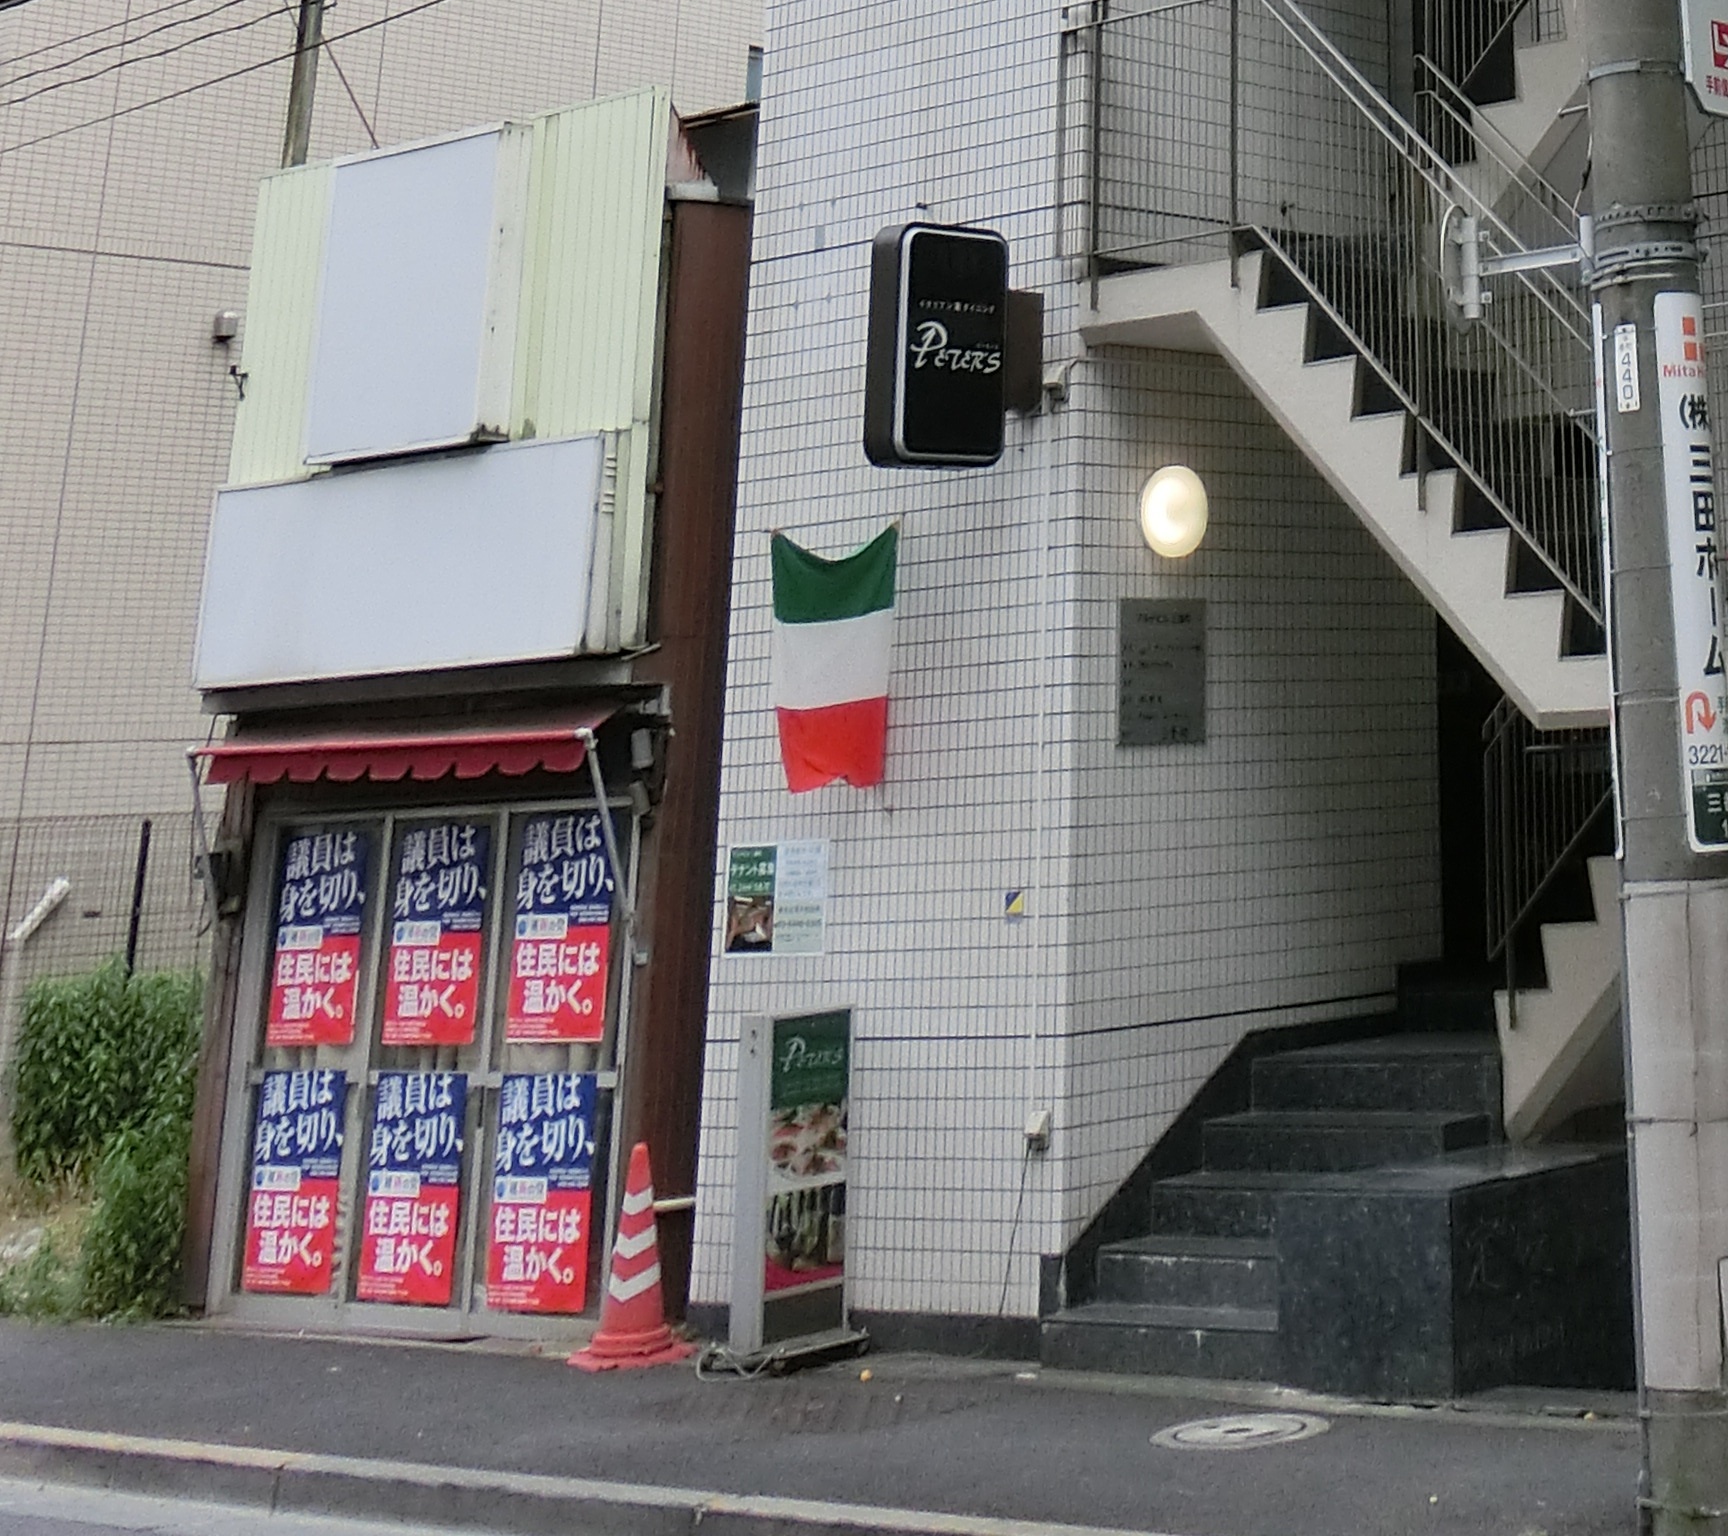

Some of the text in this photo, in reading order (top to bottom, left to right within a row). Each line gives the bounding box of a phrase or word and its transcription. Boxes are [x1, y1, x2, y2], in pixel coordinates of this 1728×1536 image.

[1621, 352, 1634, 400] 440
[286, 831, 357, 881] 議員は
[401, 824, 476, 875] 議員は
[523, 815, 602, 865] 議員は
[279, 869, 366, 923] 身を切り、
[394, 865, 486, 919] 身を切り、
[517, 854, 614, 910] 身を切り、
[277, 951, 352, 986] 住民には
[393, 948, 473, 982] 住民には
[516, 942, 600, 978] 住民には
[282, 986, 344, 1021] 温かく。
[398, 985, 465, 1019] 温かく。
[523, 979, 593, 1016] 温かく。
[262, 1068, 335, 1117] 議員は
[376, 1073, 452, 1122] 議員は
[501, 1073, 582, 1124] 議員は
[255, 1109, 343, 1162] 身を切り、
[370, 1112, 463, 1167] 身を切り、
[495, 1114, 594, 1172] 身を切り、
[253, 1194, 330, 1230] 住民には
[368, 1200, 449, 1238] 住民には
[494, 1207, 580, 1244] 住民には
[258, 1230, 322, 1268] 温かく。
[374, 1237, 443, 1277] 温かく。
[502, 1245, 574, 1285] 温かく。
